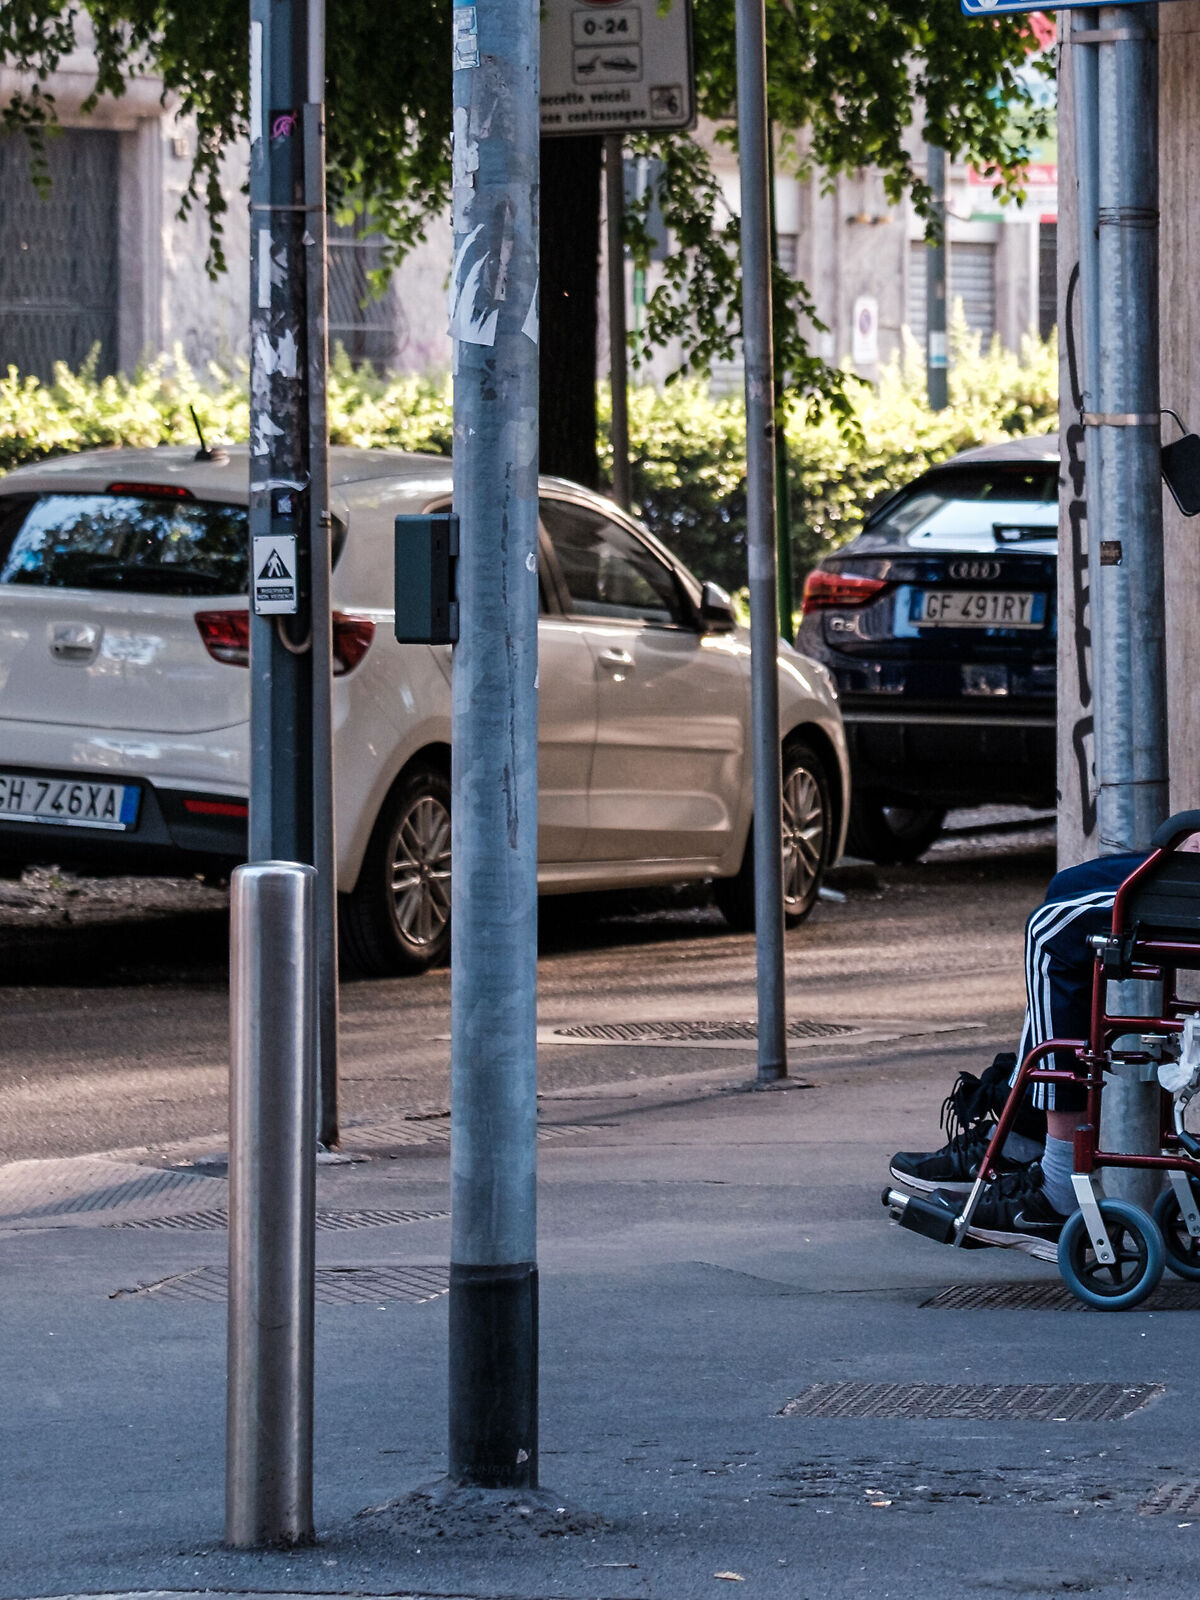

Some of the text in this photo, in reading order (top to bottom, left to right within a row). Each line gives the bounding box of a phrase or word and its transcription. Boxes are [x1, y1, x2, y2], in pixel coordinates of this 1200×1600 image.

[926, 595, 1030, 624] GF 491RY
[33, 782, 116, 818] 746XA
